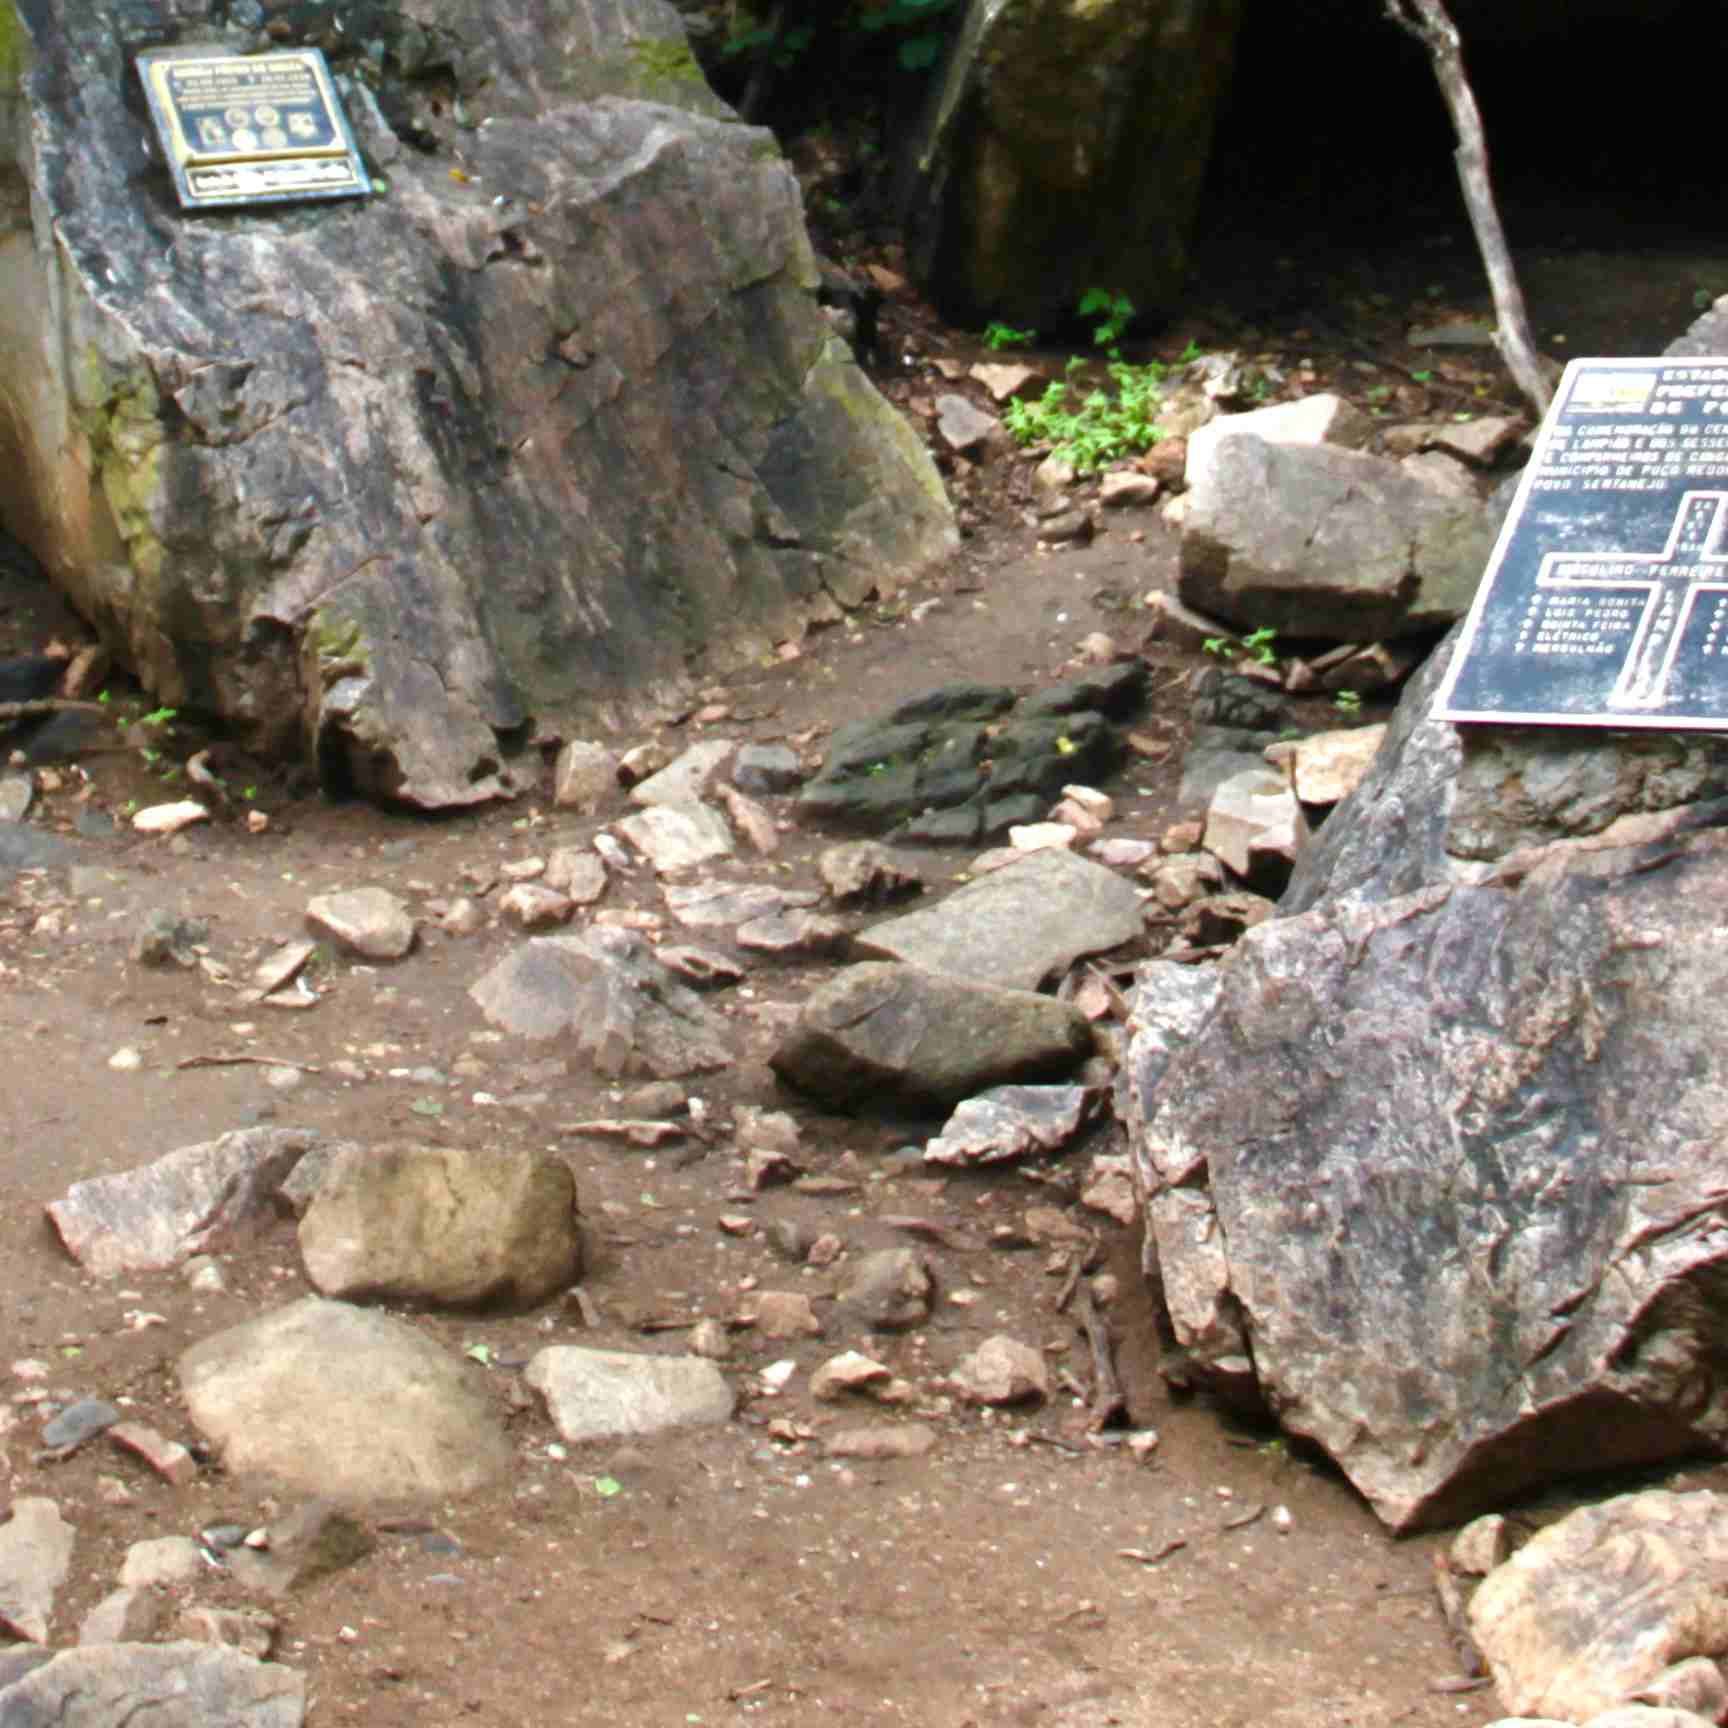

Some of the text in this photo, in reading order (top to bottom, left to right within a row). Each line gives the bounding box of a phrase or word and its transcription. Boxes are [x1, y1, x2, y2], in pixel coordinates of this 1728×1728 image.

[1648, 400, 1683, 415] DE
[1615, 465, 1633, 477] DE
[1648, 563, 1724, 579] FERREIRA
[1598, 597, 1646, 607] BONITA
